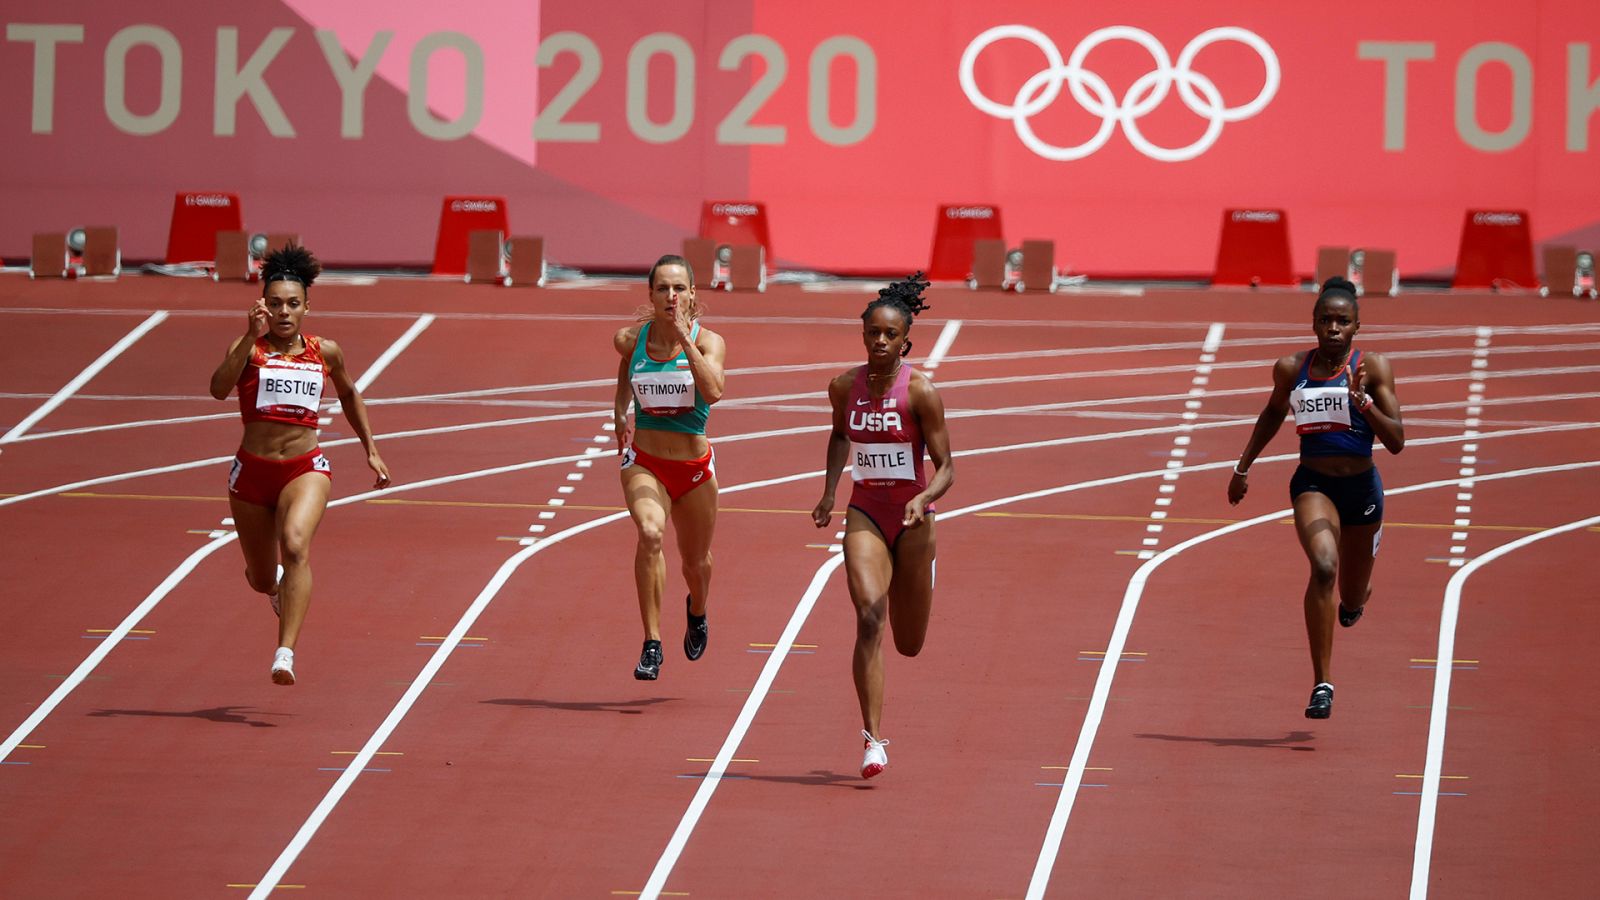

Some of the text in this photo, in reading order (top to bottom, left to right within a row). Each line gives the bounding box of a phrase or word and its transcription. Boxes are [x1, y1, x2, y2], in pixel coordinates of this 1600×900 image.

[6, 24, 879, 147] TOKYO 2020
[266, 378, 317, 396] BESTUE
[638, 383, 688, 395] EFTIMOVA
[850, 410, 902, 431] USA
[857, 451, 906, 468] BATTLE
